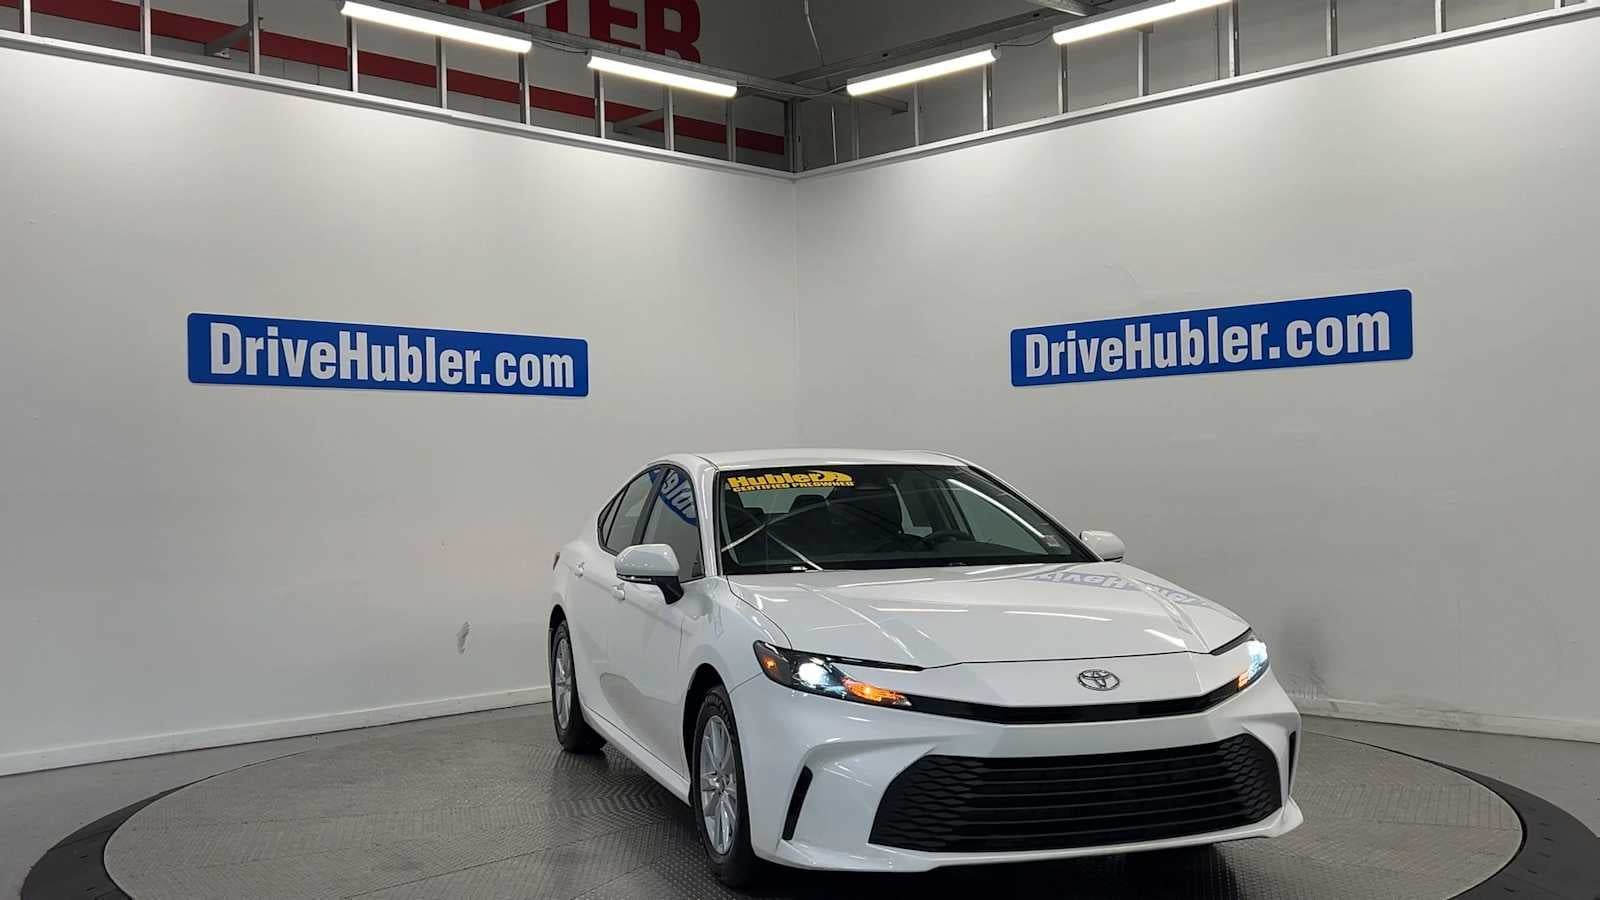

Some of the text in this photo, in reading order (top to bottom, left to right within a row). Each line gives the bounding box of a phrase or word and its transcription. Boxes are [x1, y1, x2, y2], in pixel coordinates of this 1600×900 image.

[209, 321, 575, 389] DriveHubler.com
[1025, 309, 1391, 378] DriveHubler.com
[727, 472, 825, 488] Hubler
